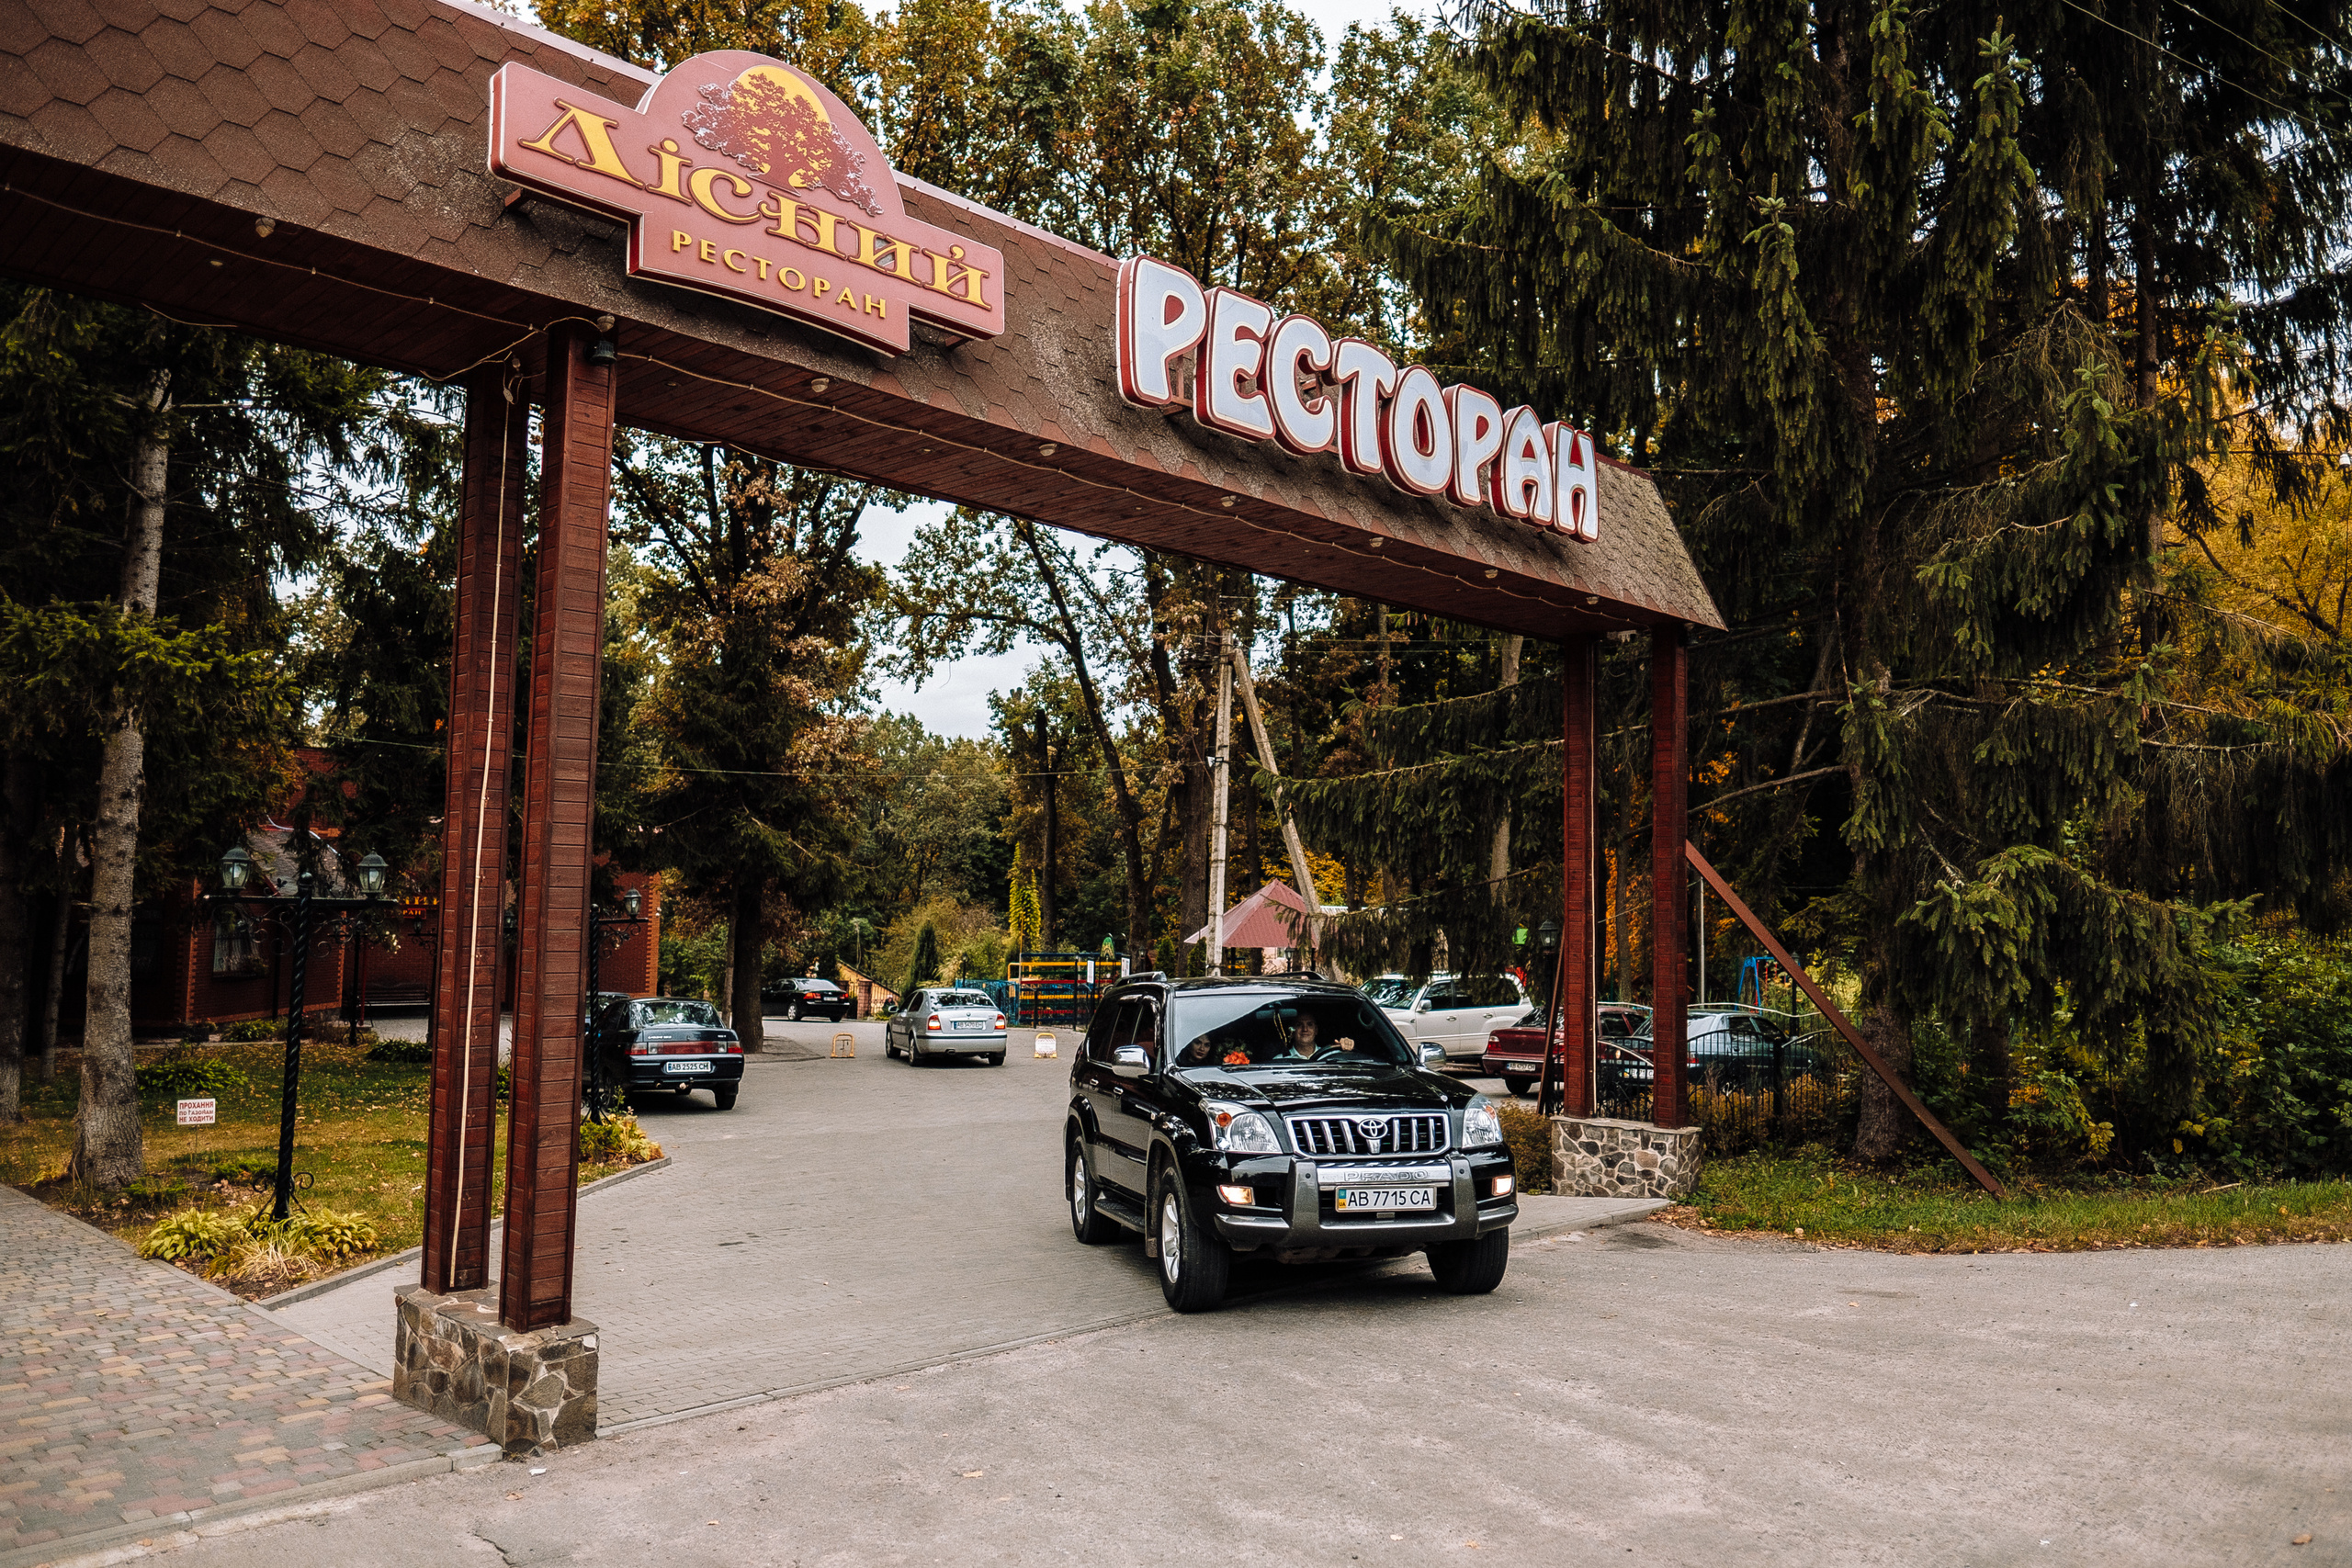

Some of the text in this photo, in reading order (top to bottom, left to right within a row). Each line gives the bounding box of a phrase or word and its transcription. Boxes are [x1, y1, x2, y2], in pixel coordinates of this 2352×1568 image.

[672, 230, 887, 319] РЕСТОРАН
[1116, 254, 1600, 544] РЕСТОРАН
[683, 1063, 697, 1071] 2525
[179, 1101, 213, 1110] ПРОХАННЯ
[1344, 1169, 1428, 1181] PRADO
[1348, 1190, 1430, 1207] AB 7715 CA
